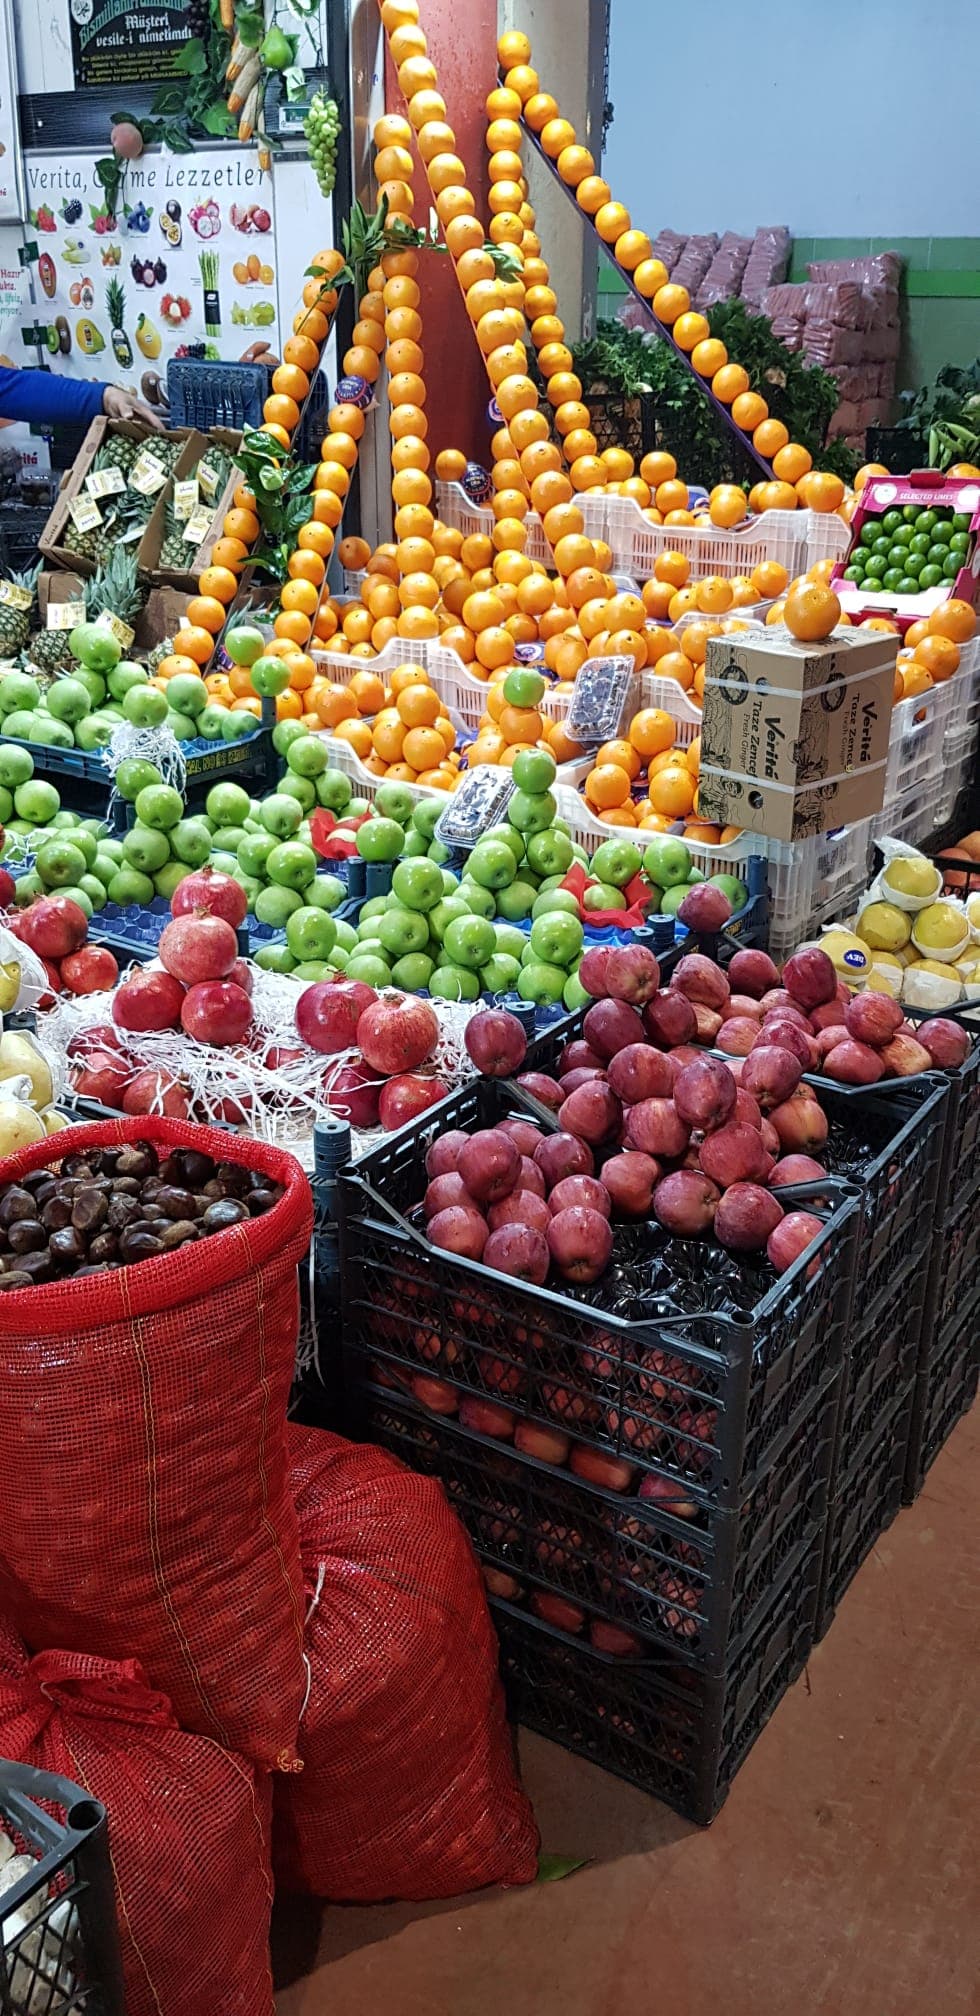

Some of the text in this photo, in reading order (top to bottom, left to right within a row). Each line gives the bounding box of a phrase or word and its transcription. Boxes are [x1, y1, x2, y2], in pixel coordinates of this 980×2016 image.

[96, 30, 133, 47] vesile-i
[124, 12, 169, 34] Müşteri
[28, 165, 87, 193] Verita,
[165, 161, 264, 187] Lezzetler
[899, 492, 953, 501] SELECTED LIMES
[751, 701, 763, 733] Taze
[849, 692, 860, 725] Taze
[742, 713, 751, 738] Fresh
[860, 701, 878, 762] Veritá
[764, 717, 786, 780] Veritá
